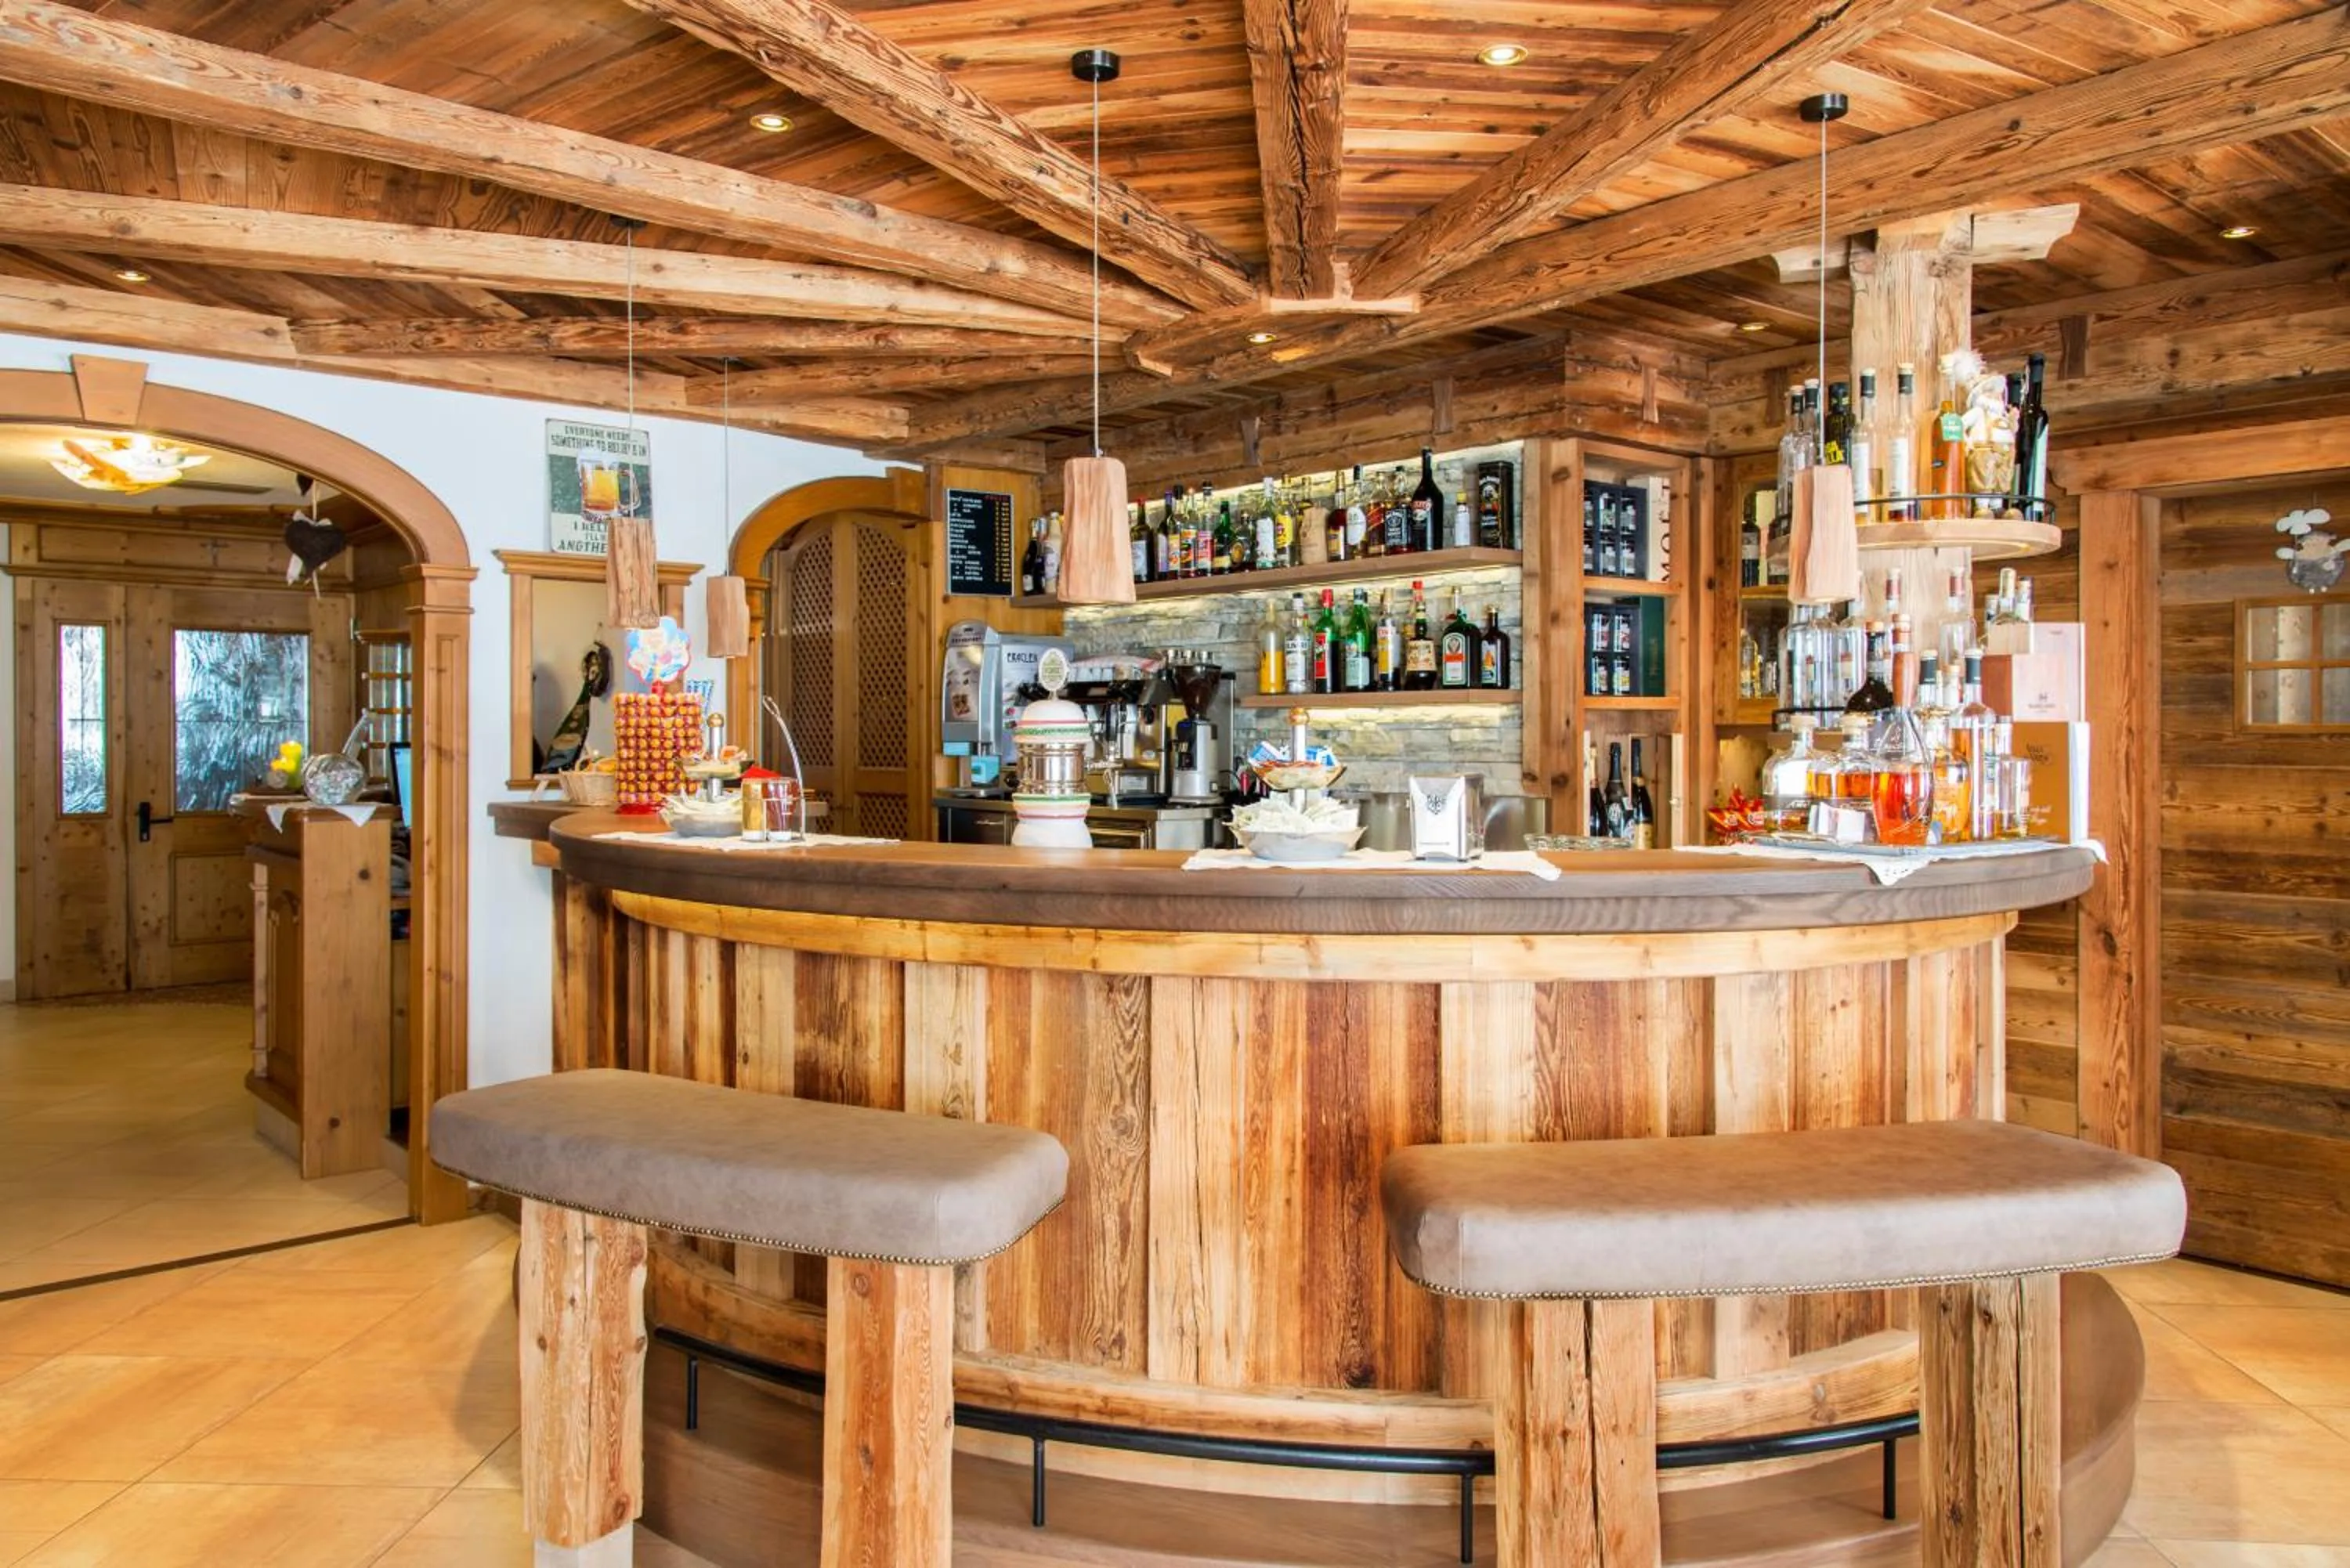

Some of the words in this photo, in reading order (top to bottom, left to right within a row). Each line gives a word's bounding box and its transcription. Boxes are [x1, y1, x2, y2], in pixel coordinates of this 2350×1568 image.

[564, 425, 606, 439] EVERYONE
[596, 439, 606, 452] TO
[638, 444, 647, 457] IN
[573, 520, 577, 531] I
[558, 539, 609, 554] ANOTHE
